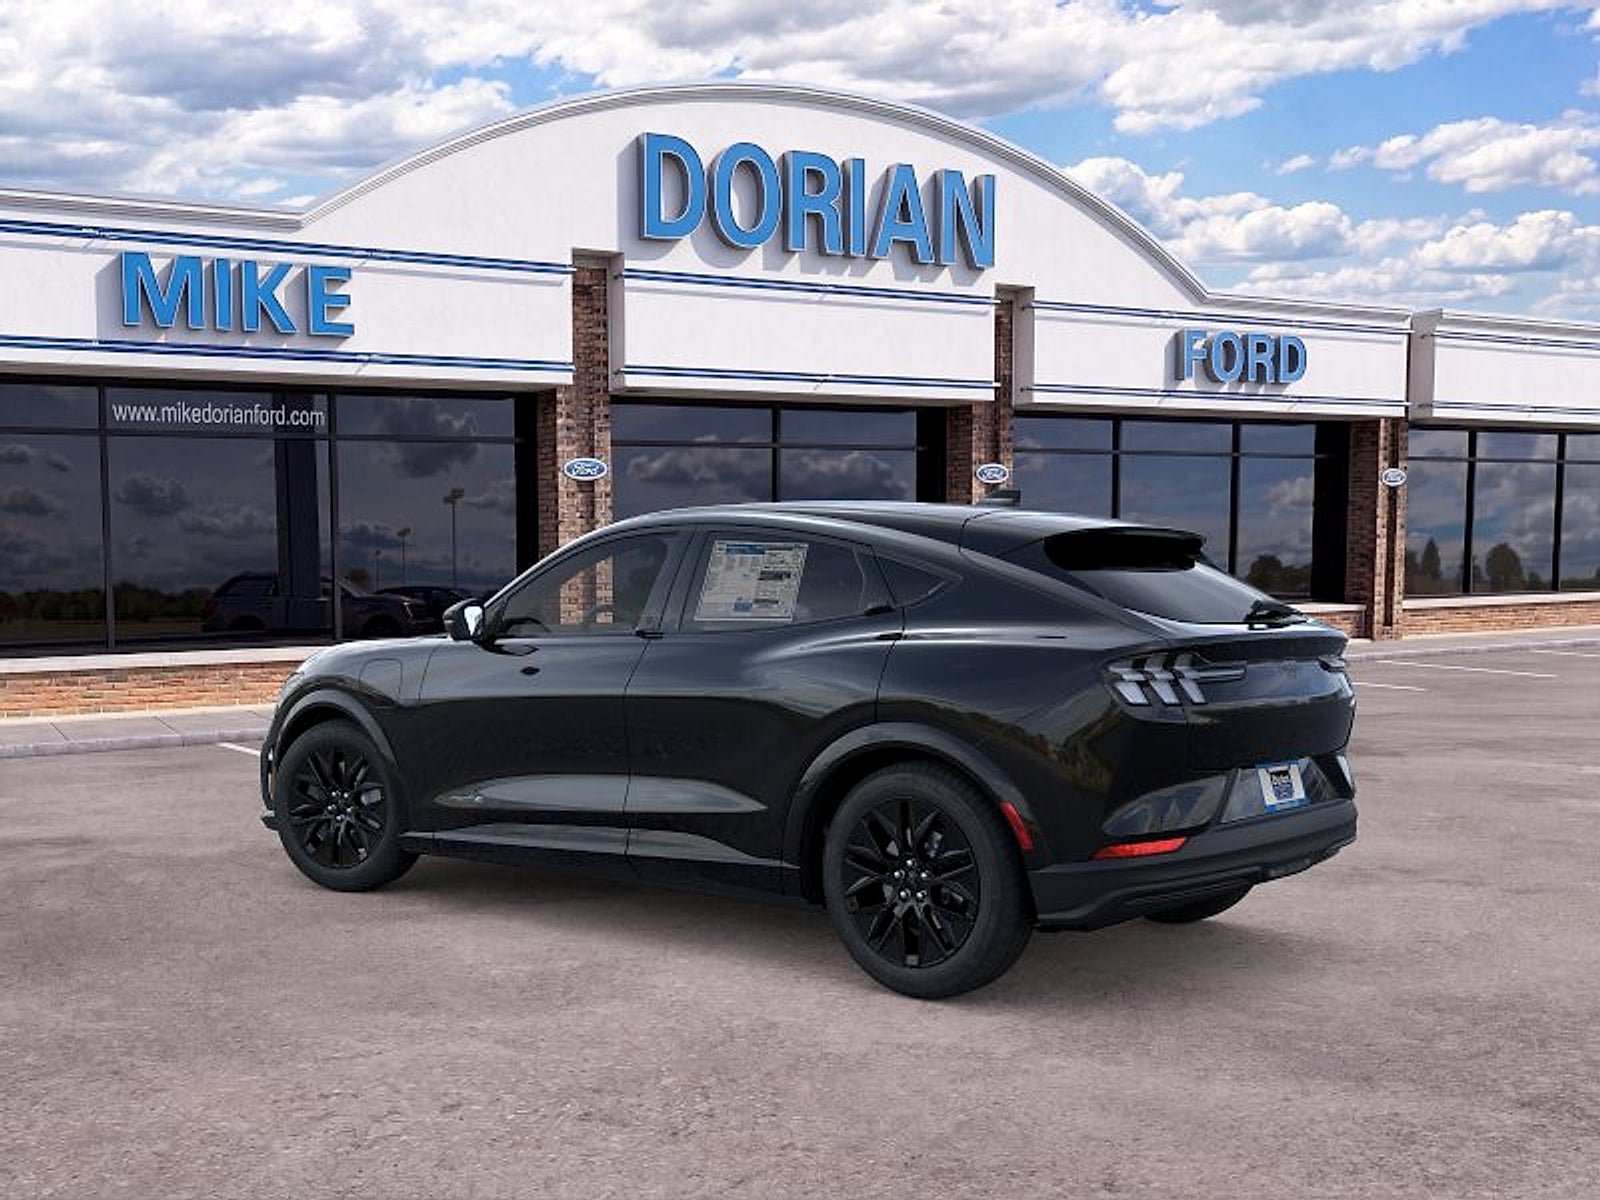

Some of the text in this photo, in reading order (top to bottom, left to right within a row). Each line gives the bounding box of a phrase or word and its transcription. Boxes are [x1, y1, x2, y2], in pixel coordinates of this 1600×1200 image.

[639, 132, 996, 269] DORIAN
[121, 252, 355, 337] MIKE
[1177, 329, 1308, 383] FORD
[112, 402, 325, 426] www.mikedorianford.com
